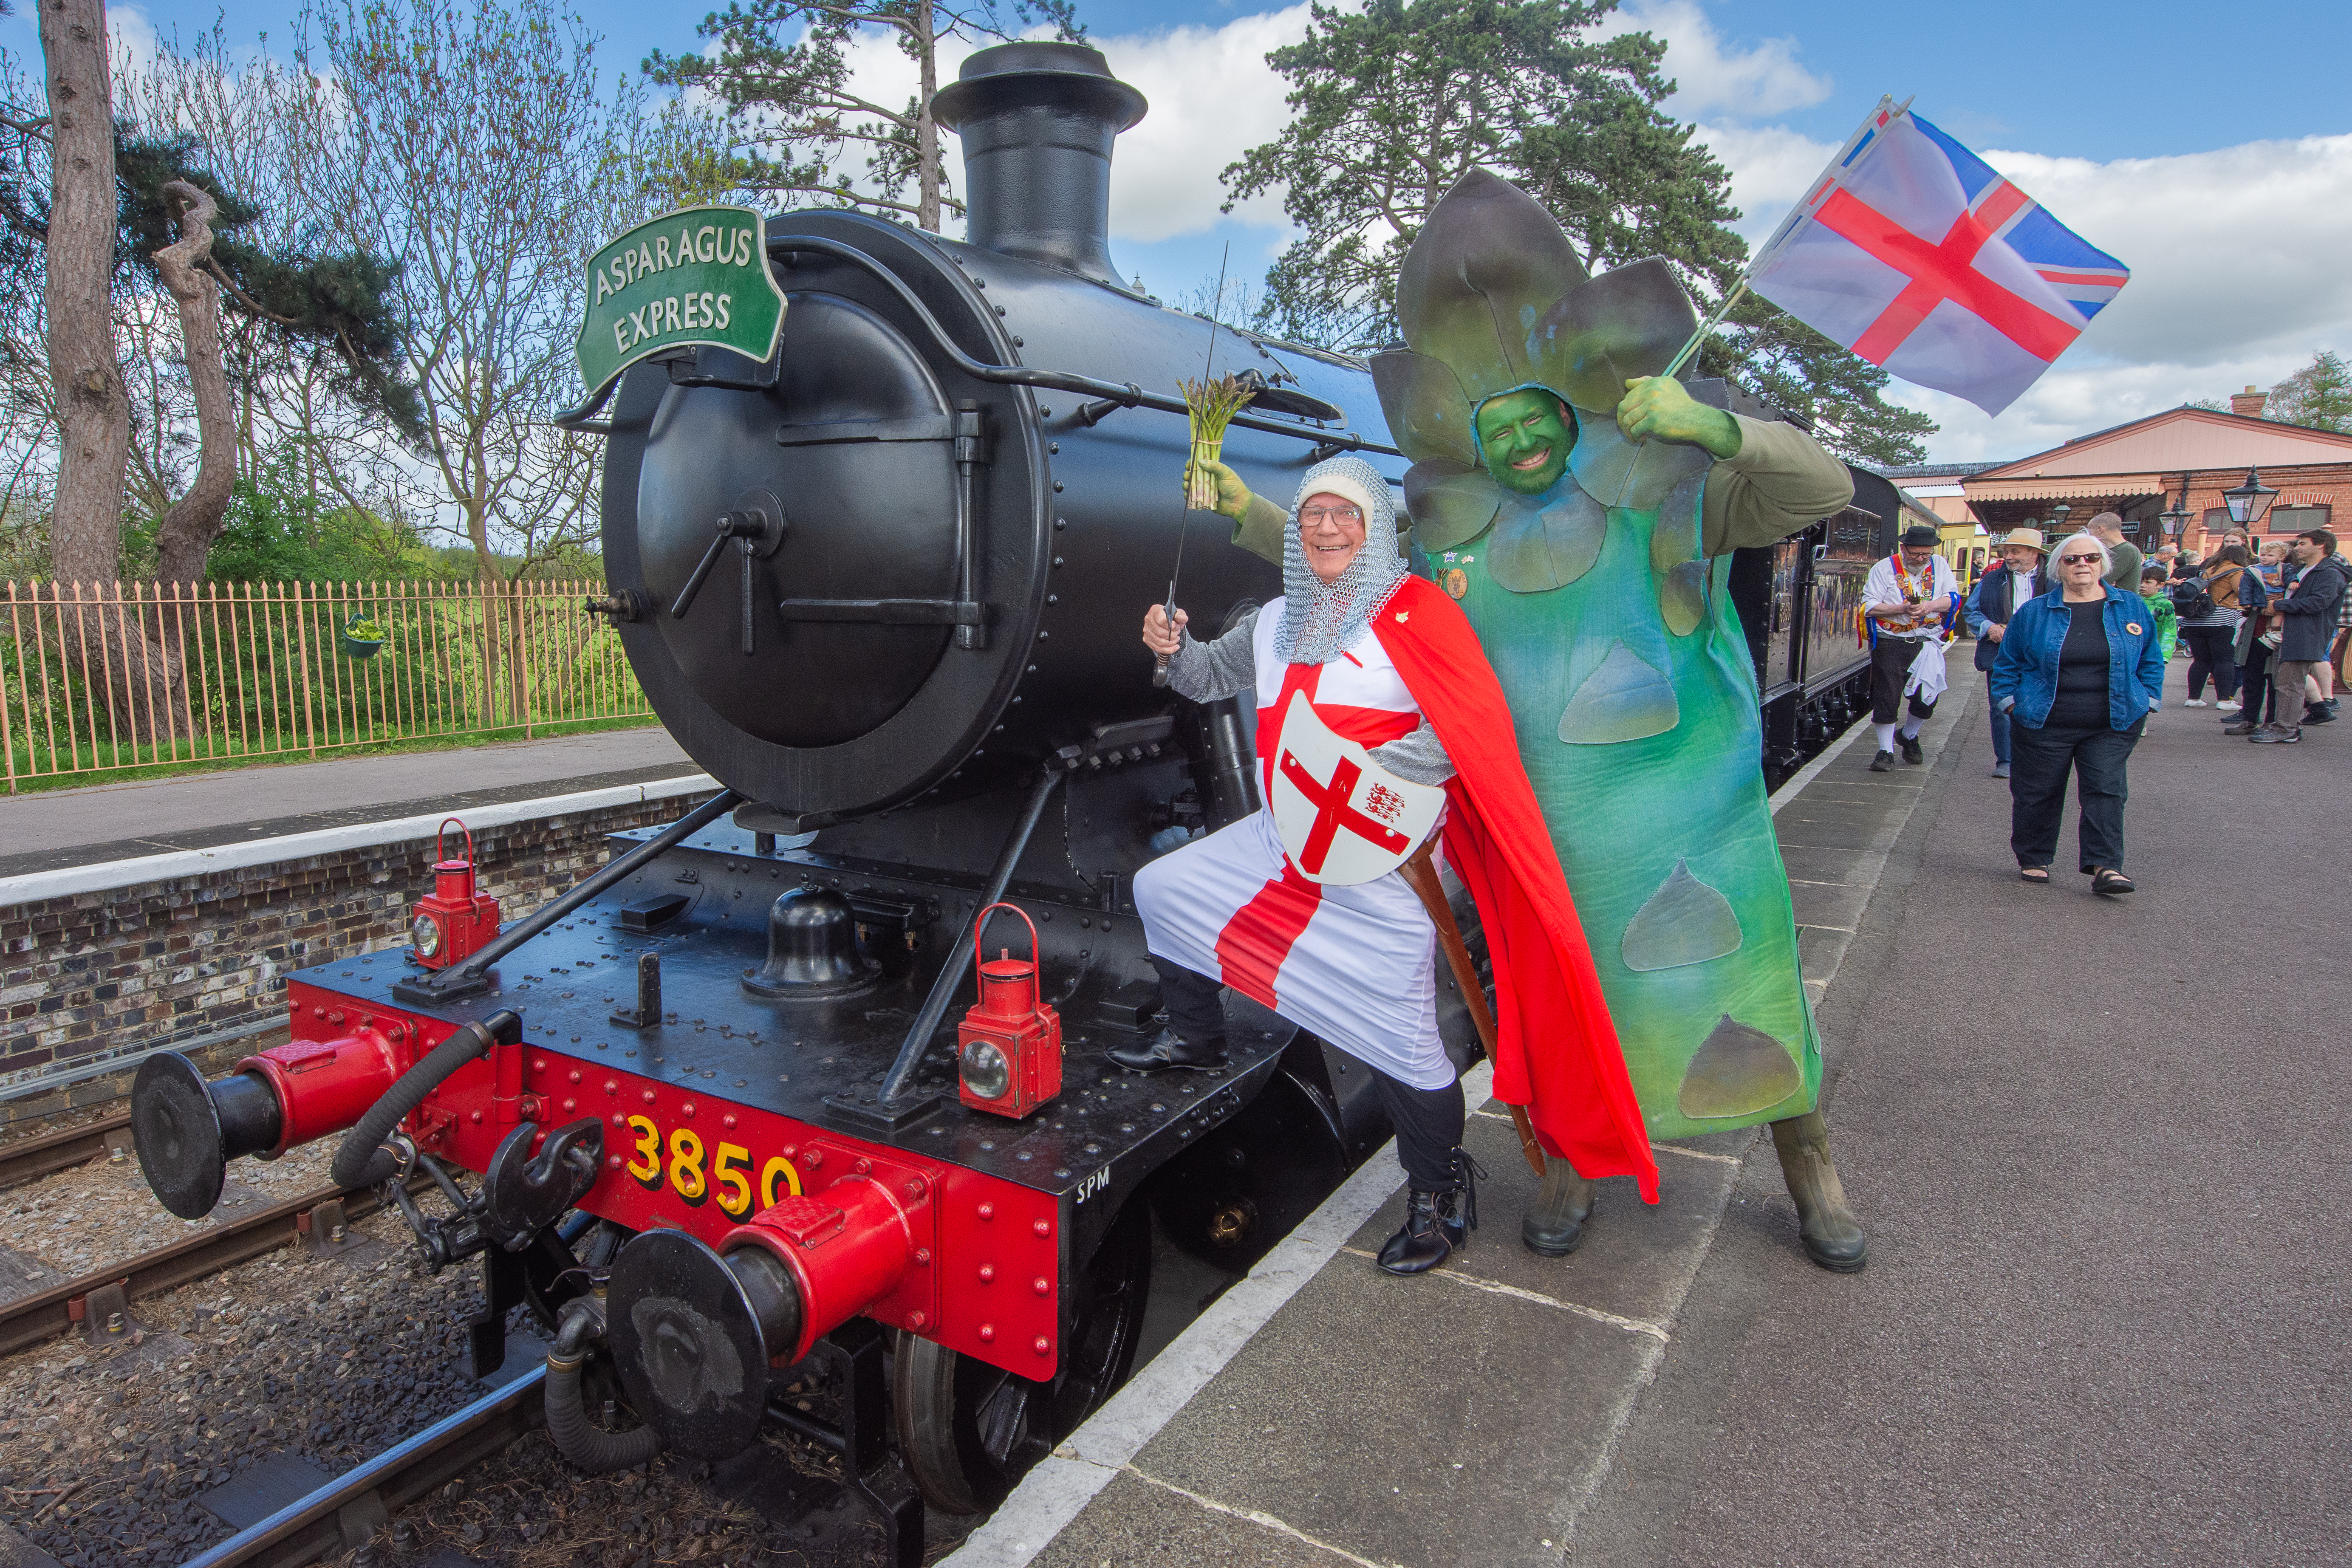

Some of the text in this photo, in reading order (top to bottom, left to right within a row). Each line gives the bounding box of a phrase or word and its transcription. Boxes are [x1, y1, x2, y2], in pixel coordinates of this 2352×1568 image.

[597, 226, 752, 306] ASPARAGUS
[613, 292, 732, 355] EXPRESS
[627, 1115, 803, 1218] 3850
[1077, 1166, 1109, 1204] SPM
